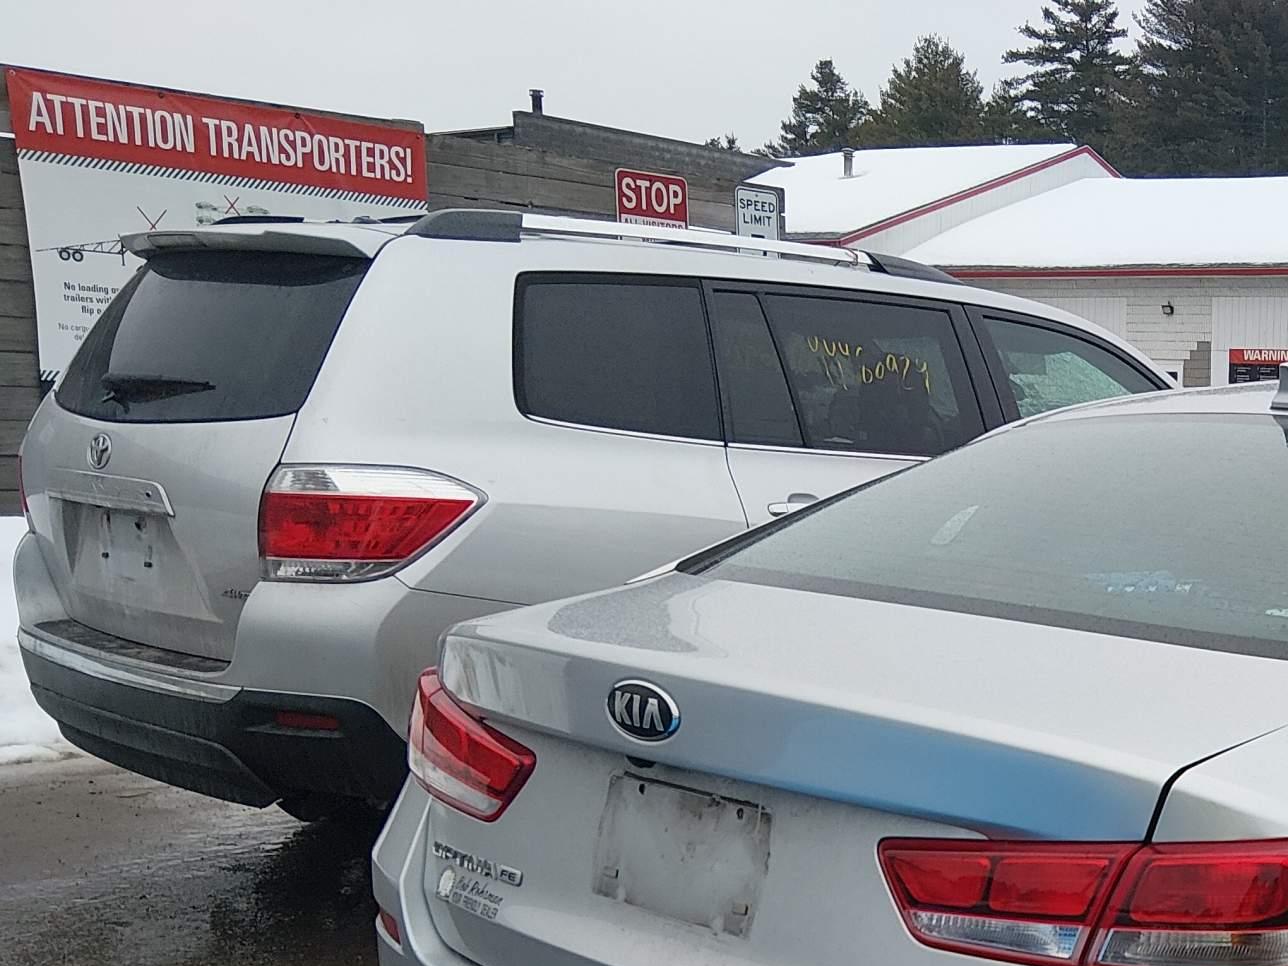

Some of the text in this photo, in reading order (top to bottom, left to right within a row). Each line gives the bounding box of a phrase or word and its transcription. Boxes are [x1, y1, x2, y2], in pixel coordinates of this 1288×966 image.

[29, 91, 413, 184] ATTENTION TRANSPORTERS!
[621, 177, 683, 214] STOP
[739, 198, 775, 213] SPEED
[742, 212, 772, 227] LIMIT
[63, 281, 76, 291] No
[78, 283, 109, 295] loading
[63, 294, 94, 303] trailers
[81, 305, 95, 316] flip
[614, 690, 665, 732] KIA
[499, 868, 517, 883] FE
